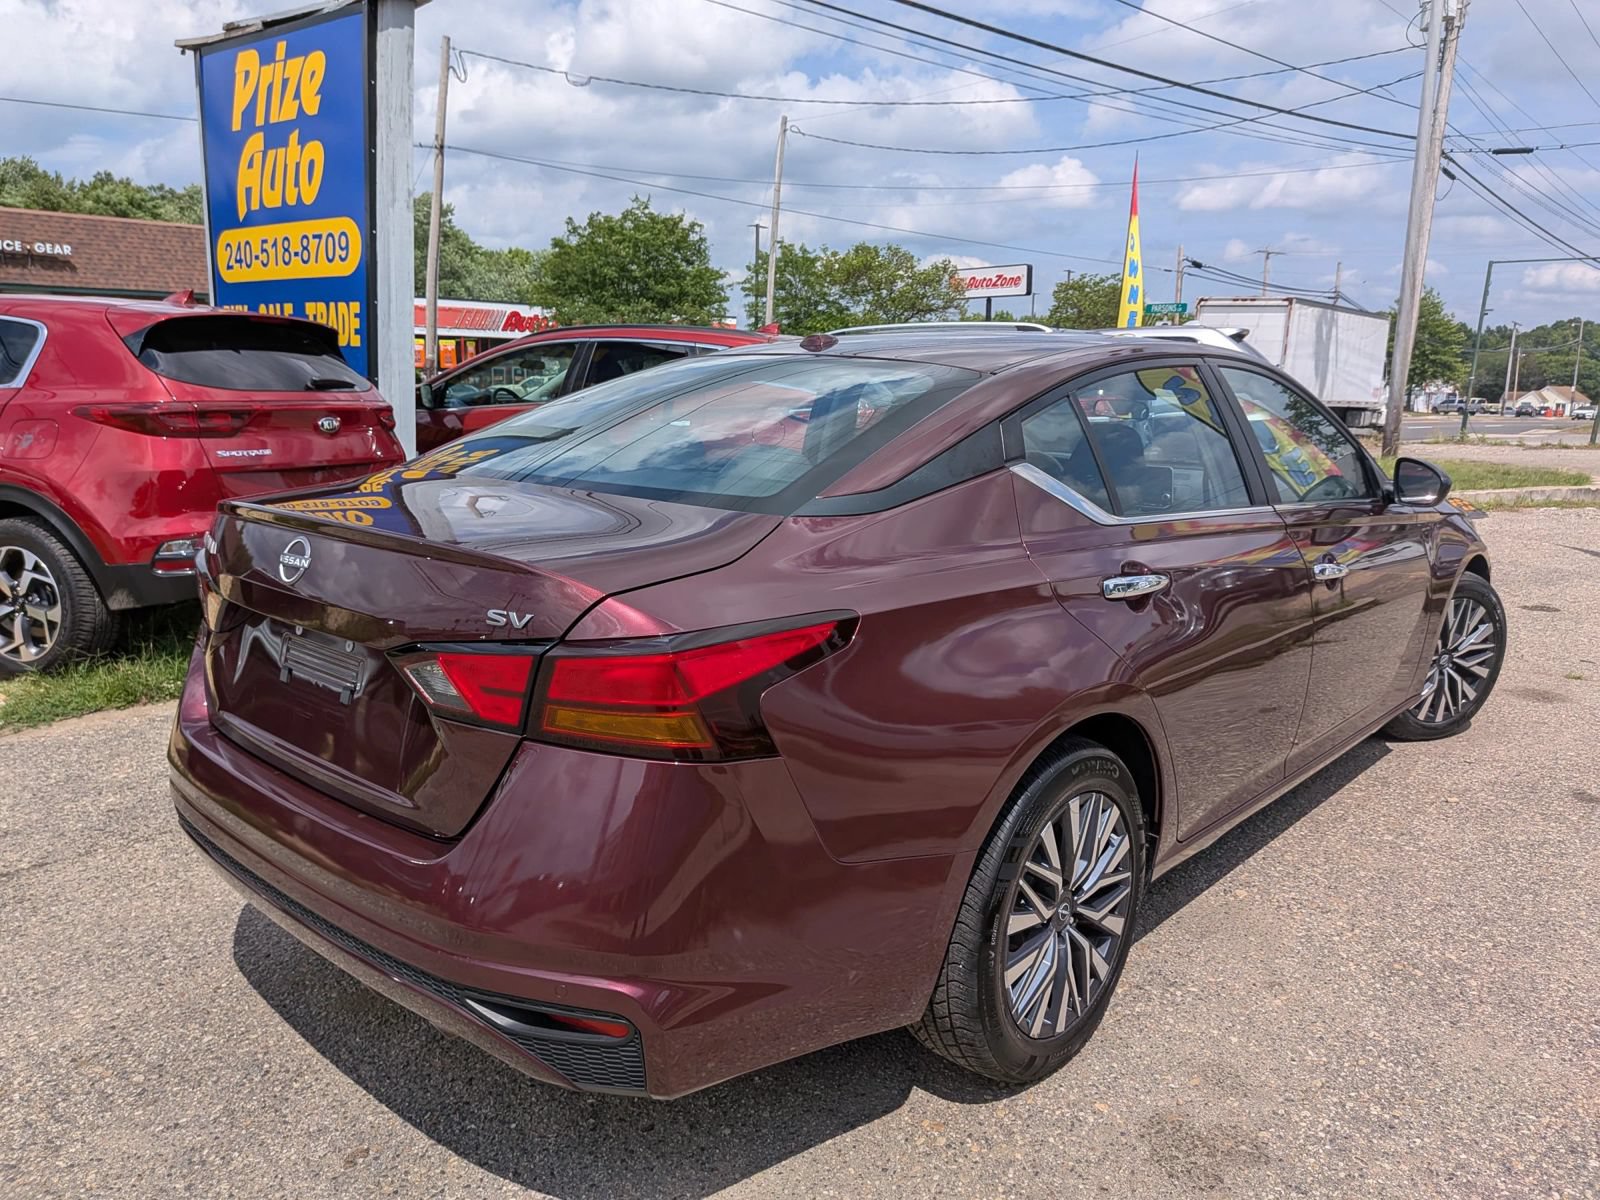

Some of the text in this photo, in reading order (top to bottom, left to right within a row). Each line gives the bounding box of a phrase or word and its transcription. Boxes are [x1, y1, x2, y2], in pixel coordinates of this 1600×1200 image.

[231, 41, 326, 132] Prize
[236, 128, 324, 223] Auto
[34, 242, 72, 255] GEAR
[225, 231, 349, 270] 240-518-8709
[966, 273, 1021, 289] AutoZone
[280, 554, 311, 568] ISSAN
[486, 609, 535, 629] SV
